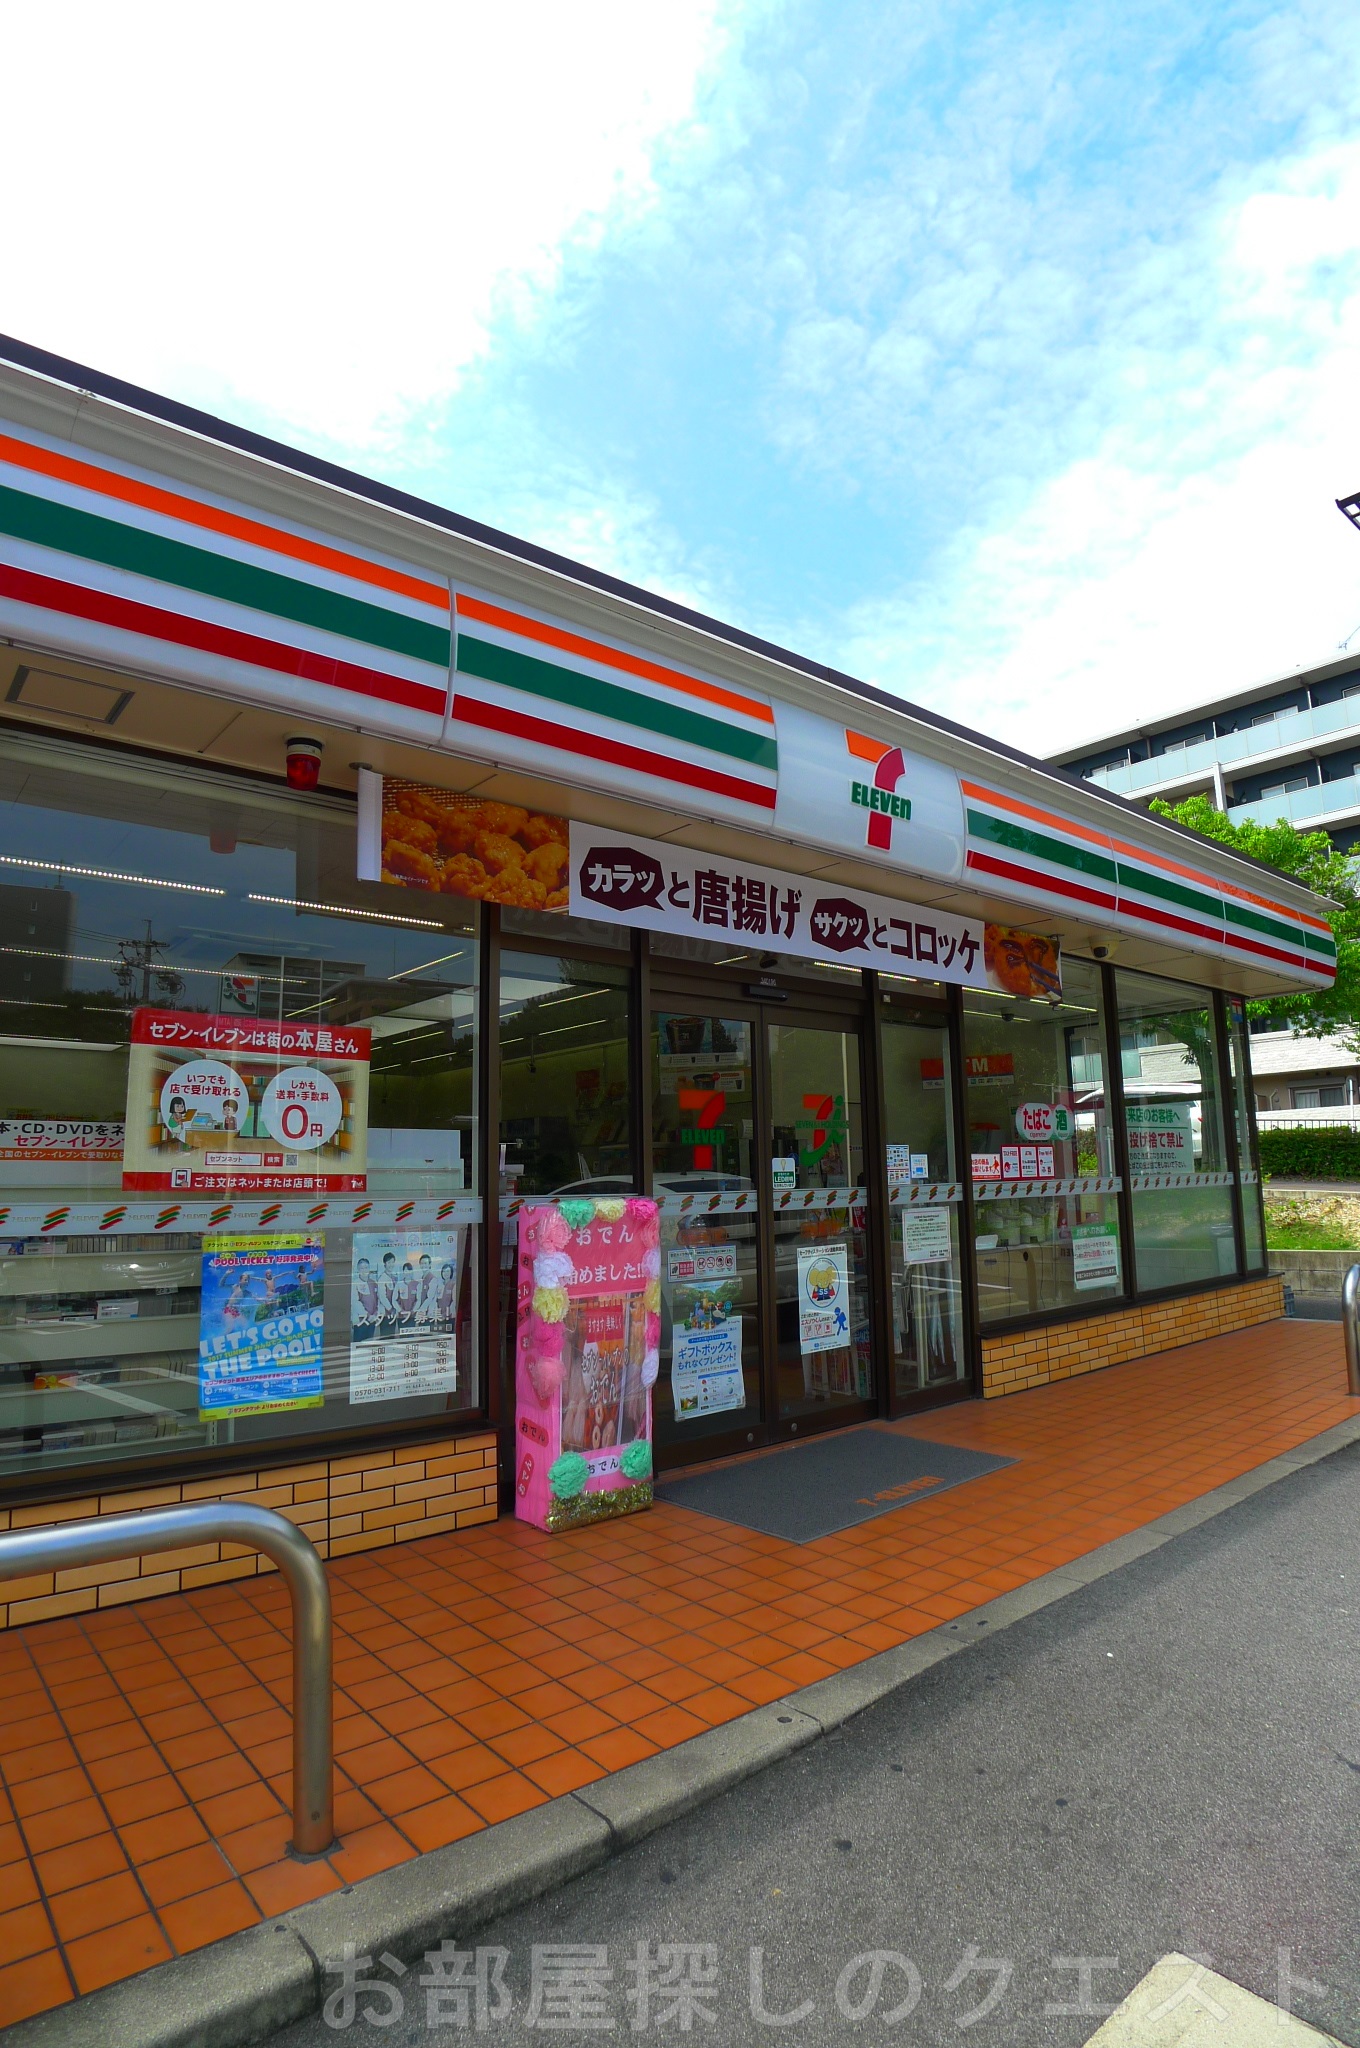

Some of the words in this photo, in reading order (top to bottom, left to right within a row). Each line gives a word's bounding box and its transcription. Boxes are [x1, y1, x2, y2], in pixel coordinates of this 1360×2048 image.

[588, 863, 802, 940] カラッと唐揚げ
[814, 912, 980, 974] サクッとコロッケ
[149, 1021, 359, 1054] セブン-イレブンは街の本屋さん
[187, 1074, 227, 1085] いつでも
[290, 1080, 316, 1090] しかも
[169, 1084, 241, 1097] 店で受け取れる
[276, 1090, 329, 1102] 送料・手数料
[281, 1103, 323, 1140] 0円
[1023, 1107, 1051, 1131] たばこ
[1055, 1109, 1068, 1131] 酒
[14, 1134, 125, 1148] セブン-イレブン
[1129, 1131, 1184, 1149] 投げ捨て禁止
[209, 1155, 243, 1163] セブンネット
[194, 1177, 327, 1189] ご注文はネットまたは店頭で!
[576, 1224, 634, 1246] おでん
[214, 1257, 239, 1266] POOL
[241, 1256, 275, 1265] TICKET
[357, 1306, 451, 1327] スタッフ募集!
[200, 1327, 258, 1358] LET'S
[262, 1318, 294, 1339] GO
[295, 1309, 324, 1331] TO
[203, 1352, 253, 1380] THE
[256, 1333, 321, 1367] POOL!
[678, 1352, 737, 1371] もれなくプレゼント!
[590, 1371, 617, 1405] おでん
